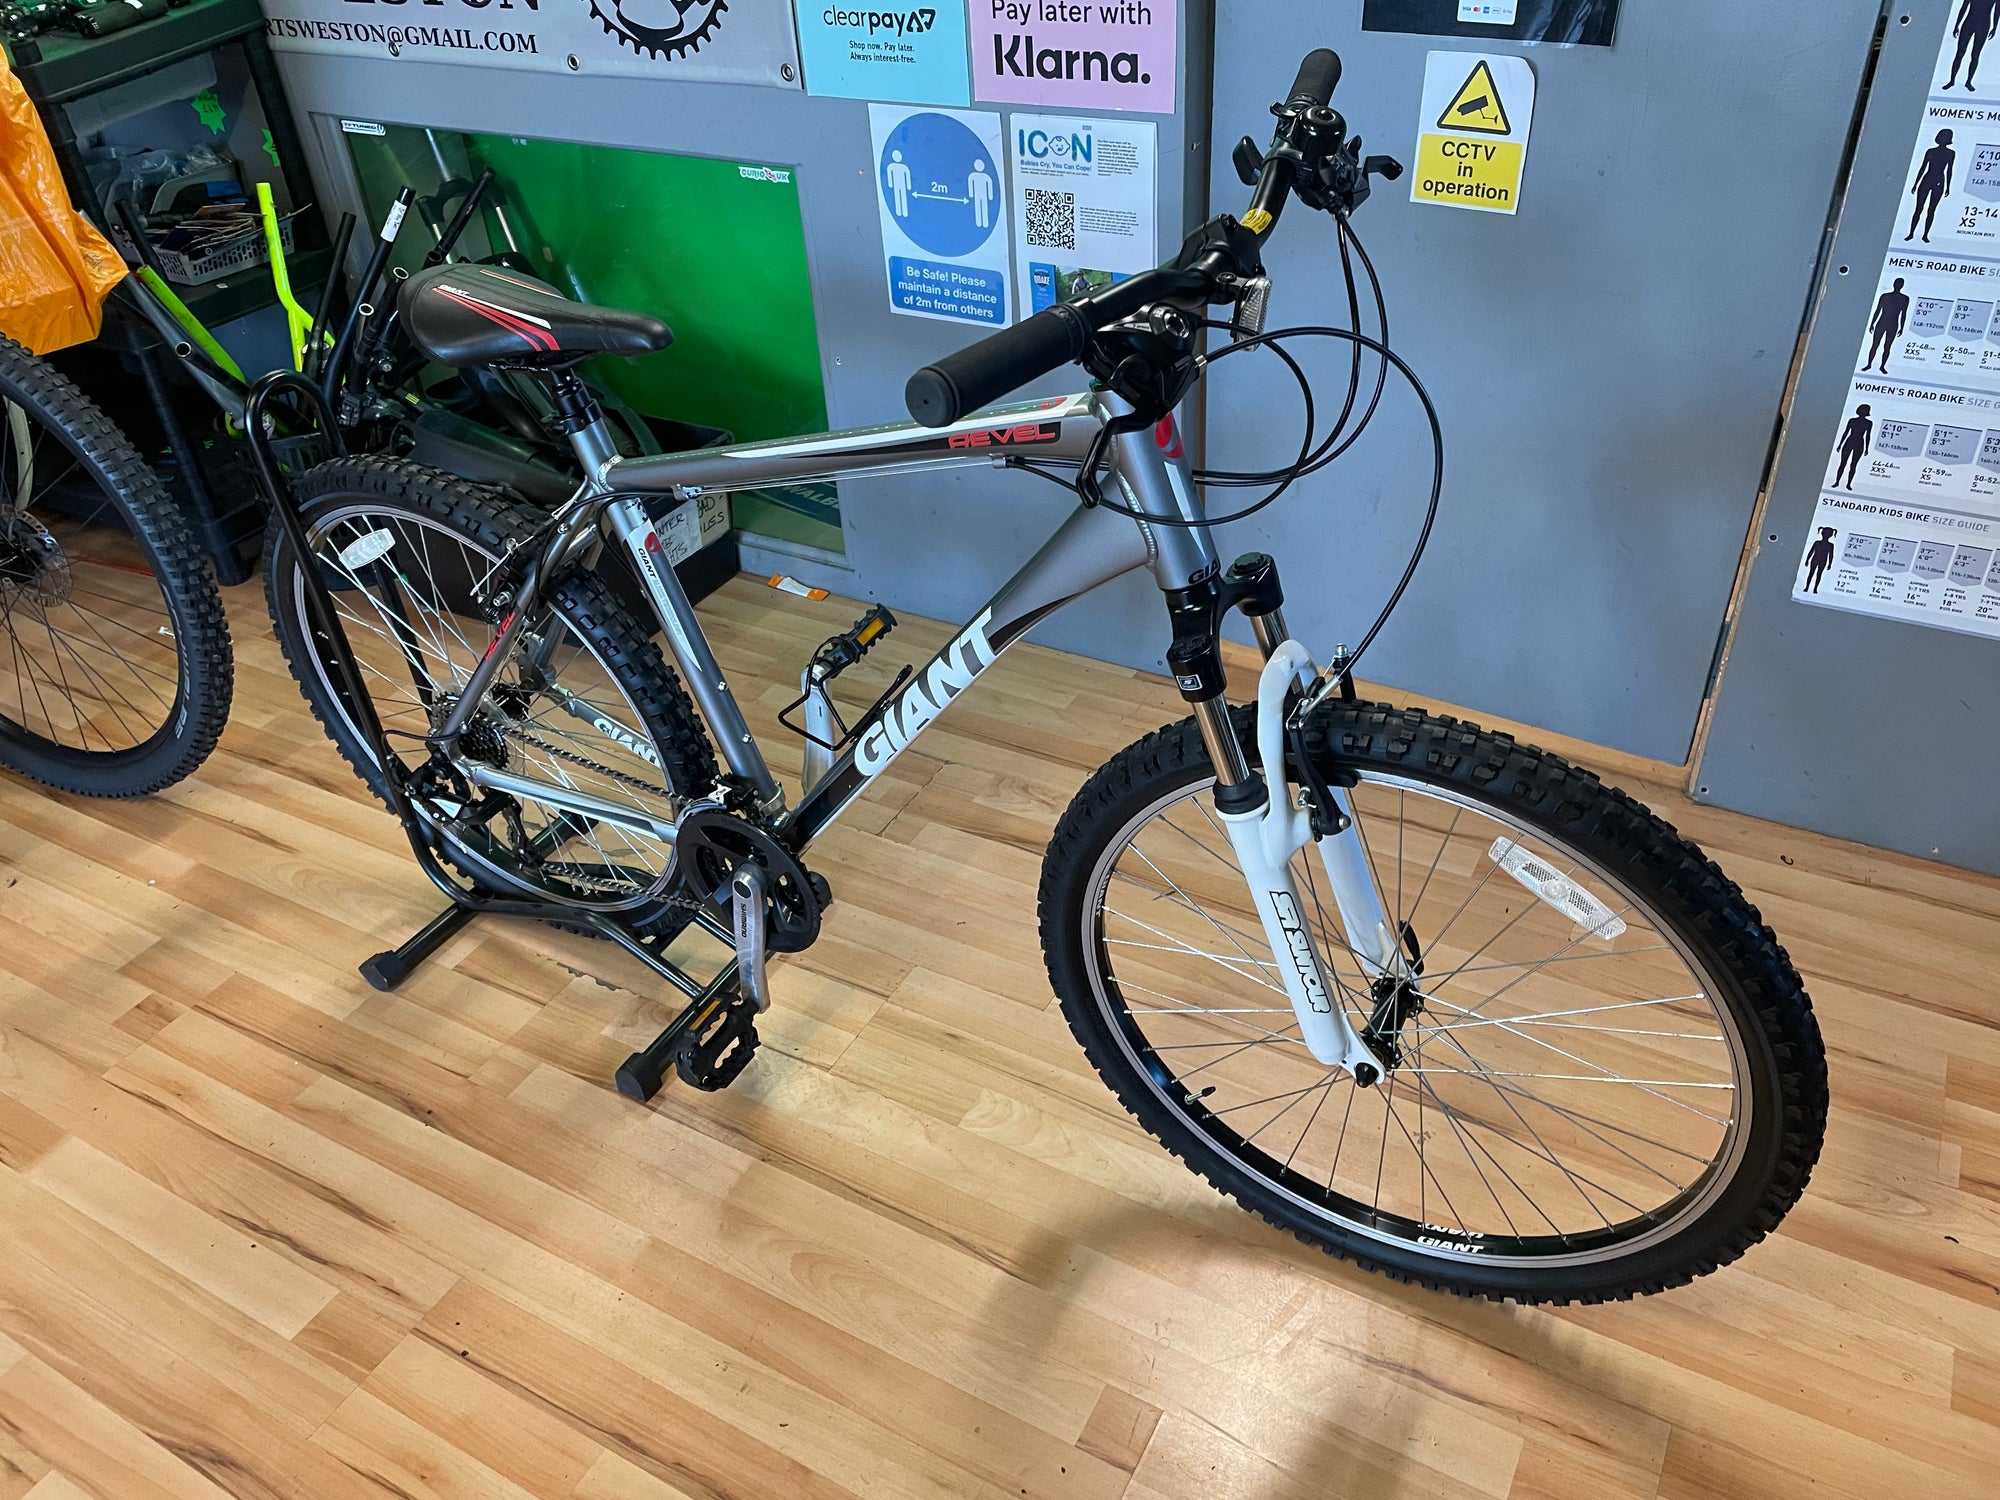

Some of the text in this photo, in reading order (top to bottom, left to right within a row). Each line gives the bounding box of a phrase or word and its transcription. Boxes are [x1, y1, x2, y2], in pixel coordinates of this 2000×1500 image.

[823, 4, 906, 37] clearpay
[992, 0, 1152, 25] Pay later with
[849, 40, 915, 52] Shop now. Pay later.
[850, 52, 917, 64] Always interest-free.
[1929, 107, 1984, 120] WOMEN'S
[1442, 141, 1497, 161] CCTV
[1457, 161, 1474, 178] in
[931, 181, 949, 194] 2m
[1423, 179, 1509, 201] operation
[1959, 217, 1977, 228] XS
[907, 266, 986, 288] Be Safe! Please
[1889, 257, 1924, 269] MEN'S
[1926, 261, 1957, 273] ROAD
[1959, 264, 1987, 276] BIKE
[898, 281, 997, 304] maintain a distance
[903, 295, 994, 318] of 2m from others
[1942, 352, 1954, 360] XS
[1855, 382, 1992, 408] WOMEN'S ROAD BIKE SIZE
[948, 424, 1056, 449] REVEL
[1920, 473, 1931, 481] XS
[1822, 498, 1991, 533] STANDARD KIDS BIKE SIZE GUIDE
[638, 547, 657, 579] GIANT
[854, 606, 997, 776] GIANT
[740, 902, 748, 938] SHIMANO
[1417, 1235, 1484, 1254] GIANT
